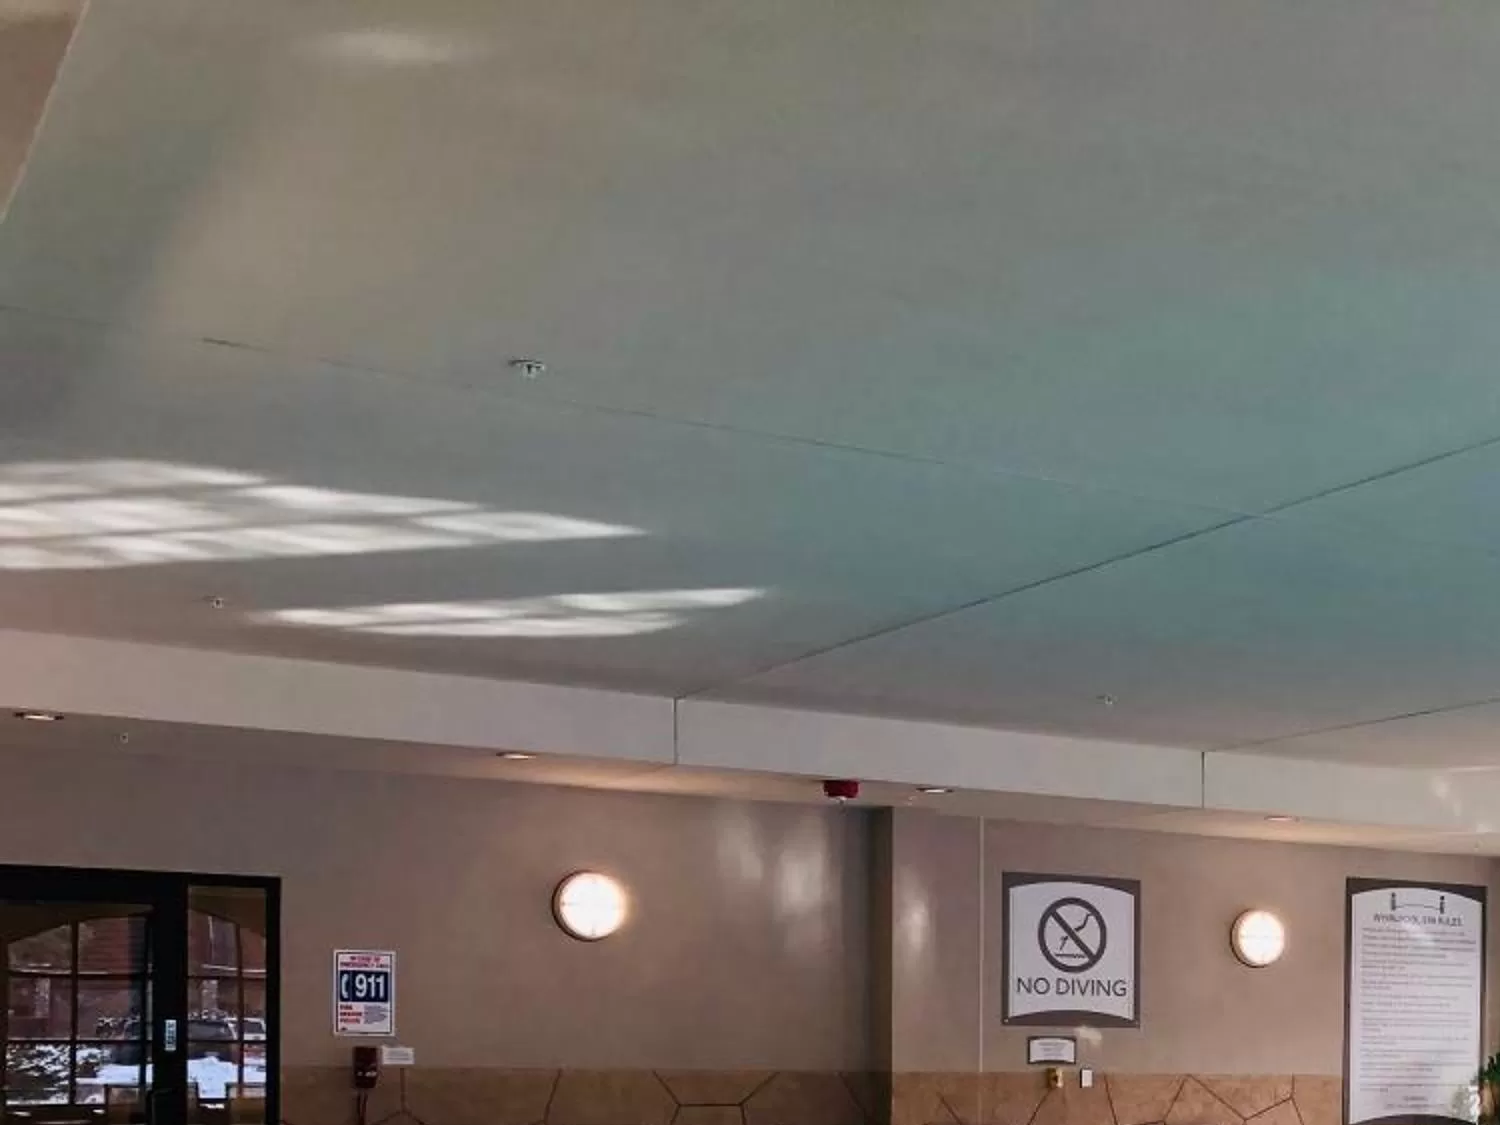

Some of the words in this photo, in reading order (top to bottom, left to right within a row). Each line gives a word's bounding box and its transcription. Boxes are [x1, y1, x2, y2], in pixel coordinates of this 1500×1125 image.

[355, 973, 385, 998] 911
[1016, 977, 1050, 995] NO
[1055, 977, 1127, 997] DIVING
